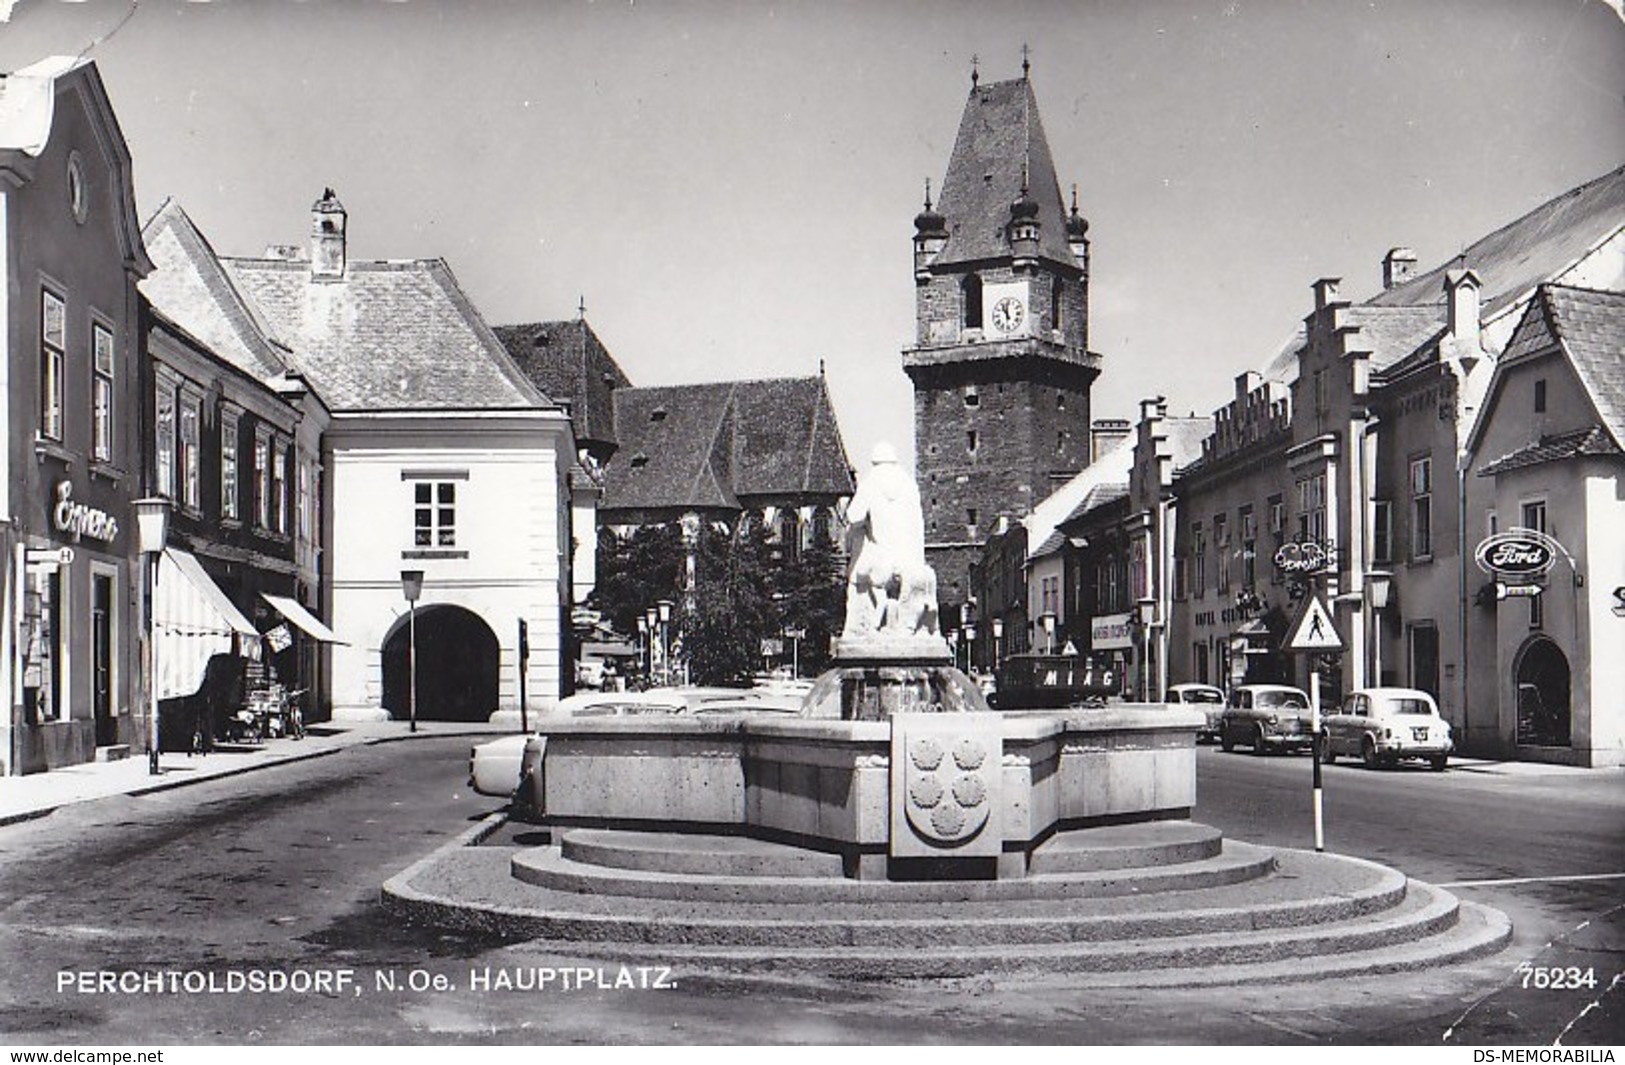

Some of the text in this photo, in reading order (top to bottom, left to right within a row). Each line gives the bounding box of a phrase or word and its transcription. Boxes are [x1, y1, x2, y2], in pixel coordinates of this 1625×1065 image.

[61, 550, 71, 562] H
[1493, 542, 1543, 566] Ford
[1043, 669, 1113, 686] MIAG
